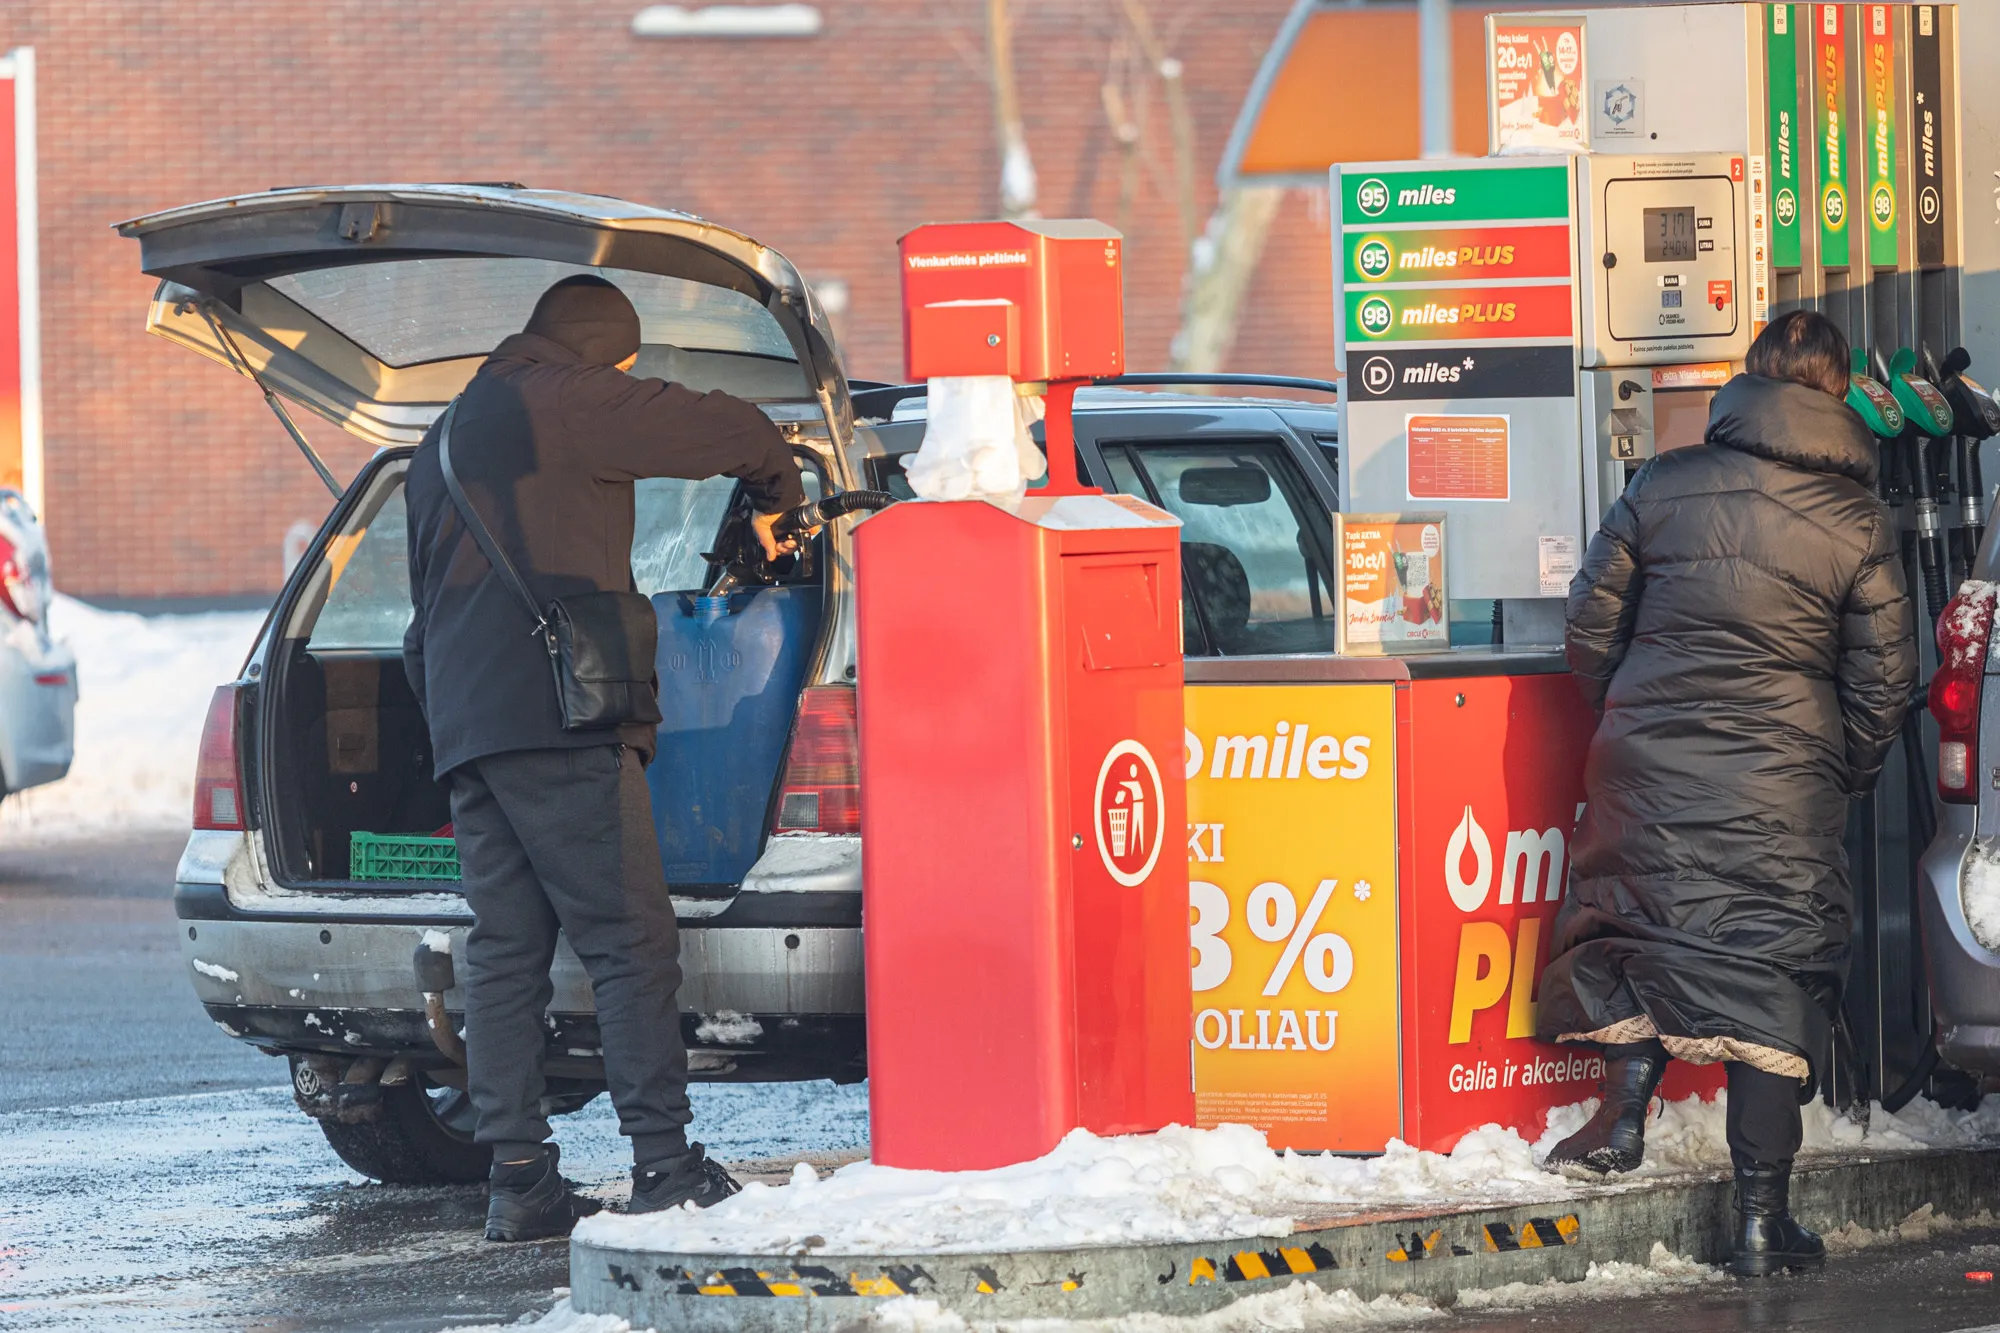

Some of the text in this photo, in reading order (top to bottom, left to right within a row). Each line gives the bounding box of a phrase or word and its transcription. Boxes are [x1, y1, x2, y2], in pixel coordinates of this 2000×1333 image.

[1825, 44, 1839, 178] milesPLUS
[1874, 43, 1888, 177] milesPLUS
[1778, 111, 1790, 179] miles
[1735, 164, 1741, 176] 2
[1361, 185, 1456, 208] 95 miles
[1875, 196, 1890, 215] 98
[1924, 196, 1935, 214] D
[1778, 198, 1793, 217] 95
[1826, 197, 1842, 217] 95
[1698, 219, 1711, 227] SUMA
[909, 252, 1027, 268] Vienkartinės pirštinės
[1363, 245, 1515, 269] 95 milesPLUS
[1363, 303, 1517, 326] 98 milesPLUS
[1370, 366, 1388, 385] D
[1679, 370, 1700, 380] Visada
[1700, 368, 1727, 380] daugiau
[1886, 410, 1898, 422] 95
[1361, 531, 1381, 539] EXTRA
[1209, 720, 1371, 780] miles
[1449, 1062, 1497, 1093] Galia
[1502, 1058, 1518, 1088] ir
